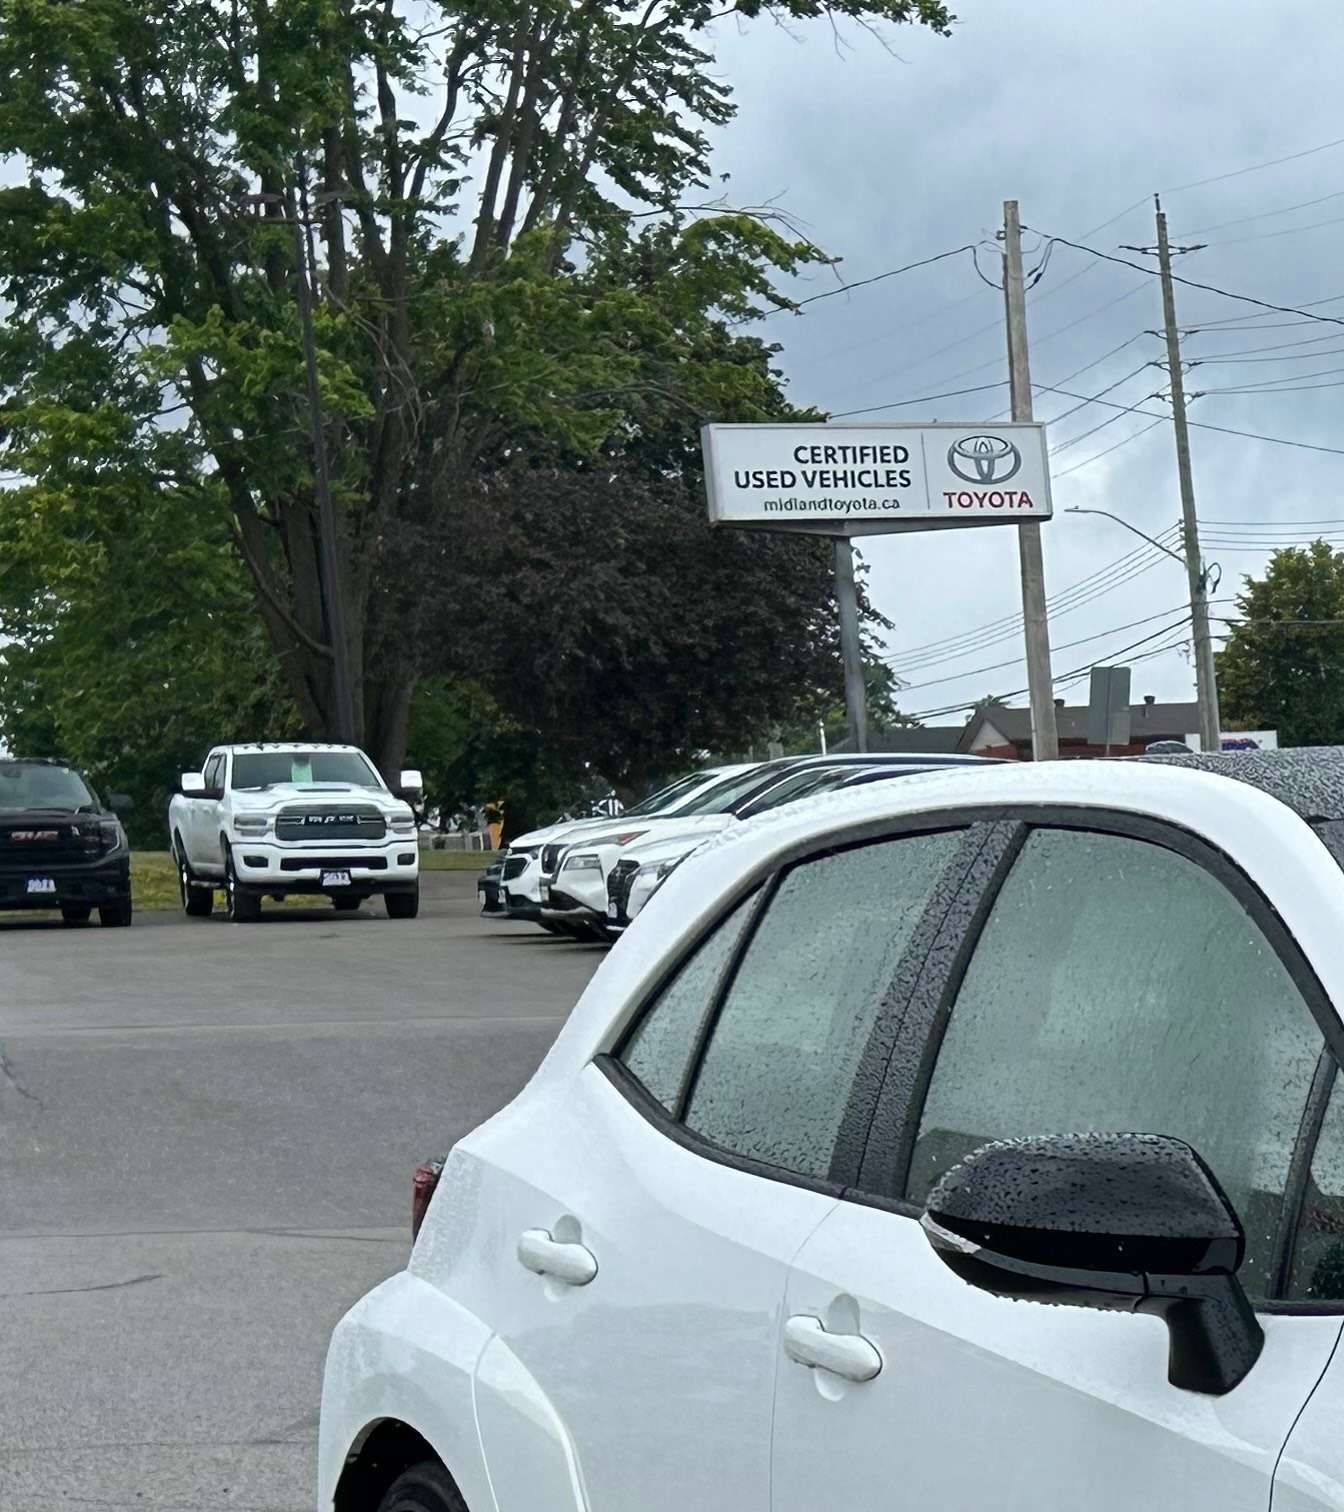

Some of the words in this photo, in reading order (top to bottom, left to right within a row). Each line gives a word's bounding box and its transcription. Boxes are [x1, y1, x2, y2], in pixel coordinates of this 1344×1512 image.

[793, 445, 909, 465] CERTIFIED
[734, 470, 796, 489] USED
[800, 469, 911, 489] VEHICLES
[763, 497, 900, 514] midlandtoyota.ca
[943, 491, 1034, 509] TOYOTA
